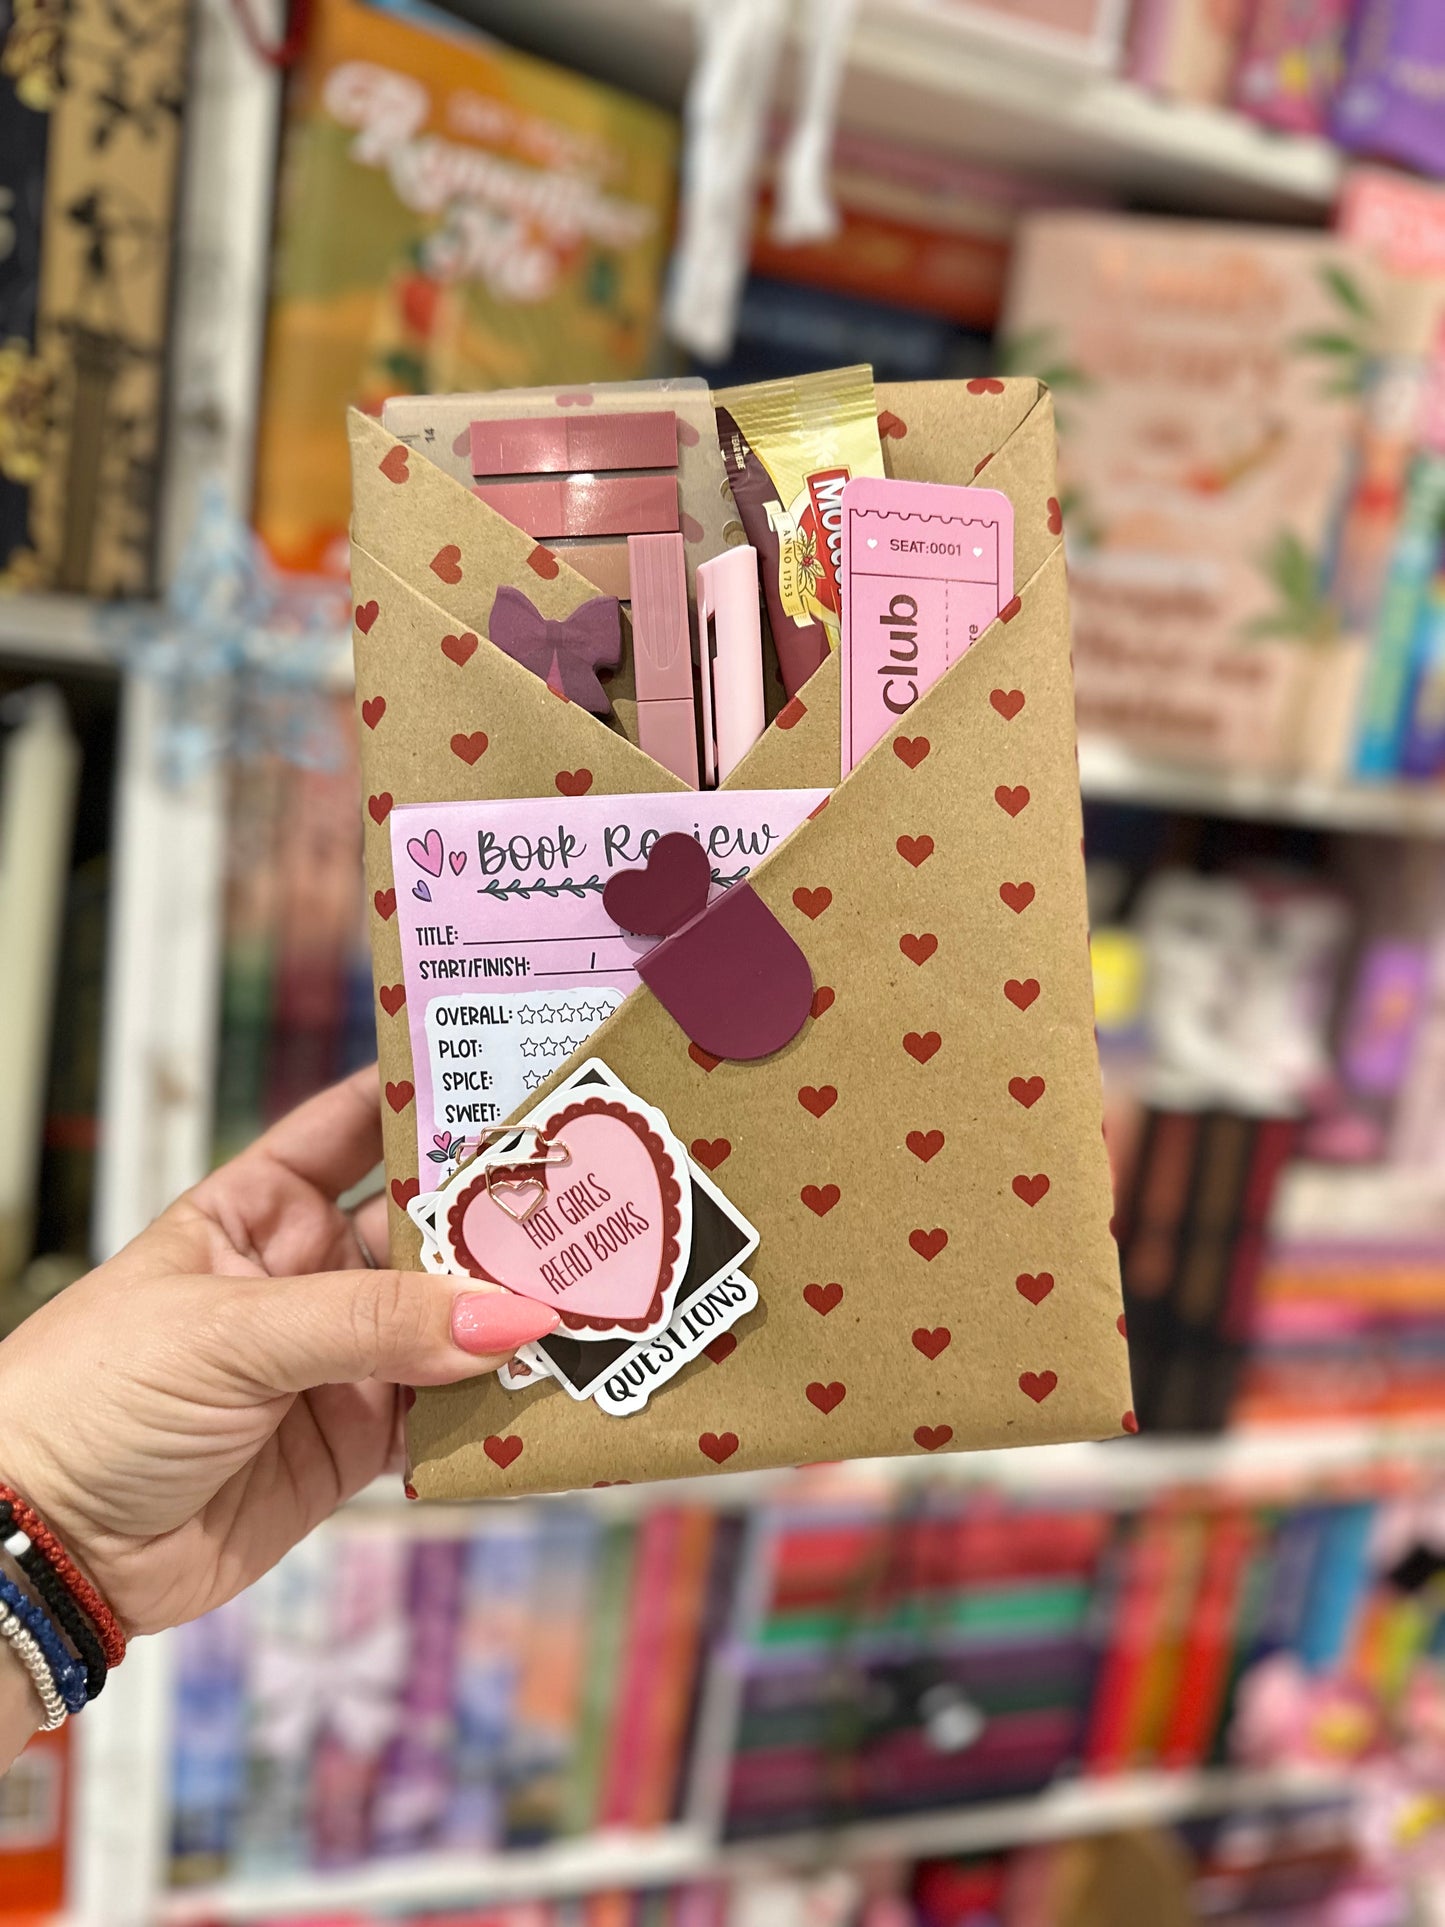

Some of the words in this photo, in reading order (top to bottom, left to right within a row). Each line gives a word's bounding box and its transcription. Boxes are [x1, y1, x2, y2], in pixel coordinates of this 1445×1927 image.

[783, 529, 792, 564] ANNO
[889, 538, 963, 557] SEAT:0001
[783, 570, 793, 598] 1753
[877, 594, 919, 715] Club
[603, 822, 780, 867] Reiew
[415, 925, 459, 946] TITLE:
[419, 956, 531, 980] START/FINISH:
[435, 1005, 513, 1026] OVERALL:
[438, 1039, 483, 1059] PLOT:
[442, 1070, 493, 1091] SPICE:
[445, 1103, 501, 1123] SWEET:
[522, 1205, 564, 1250] HOT
[556, 1172, 611, 1225] GIRLS
[539, 1242, 593, 1295] READ
[584, 1201, 650, 1262] BOOKS
